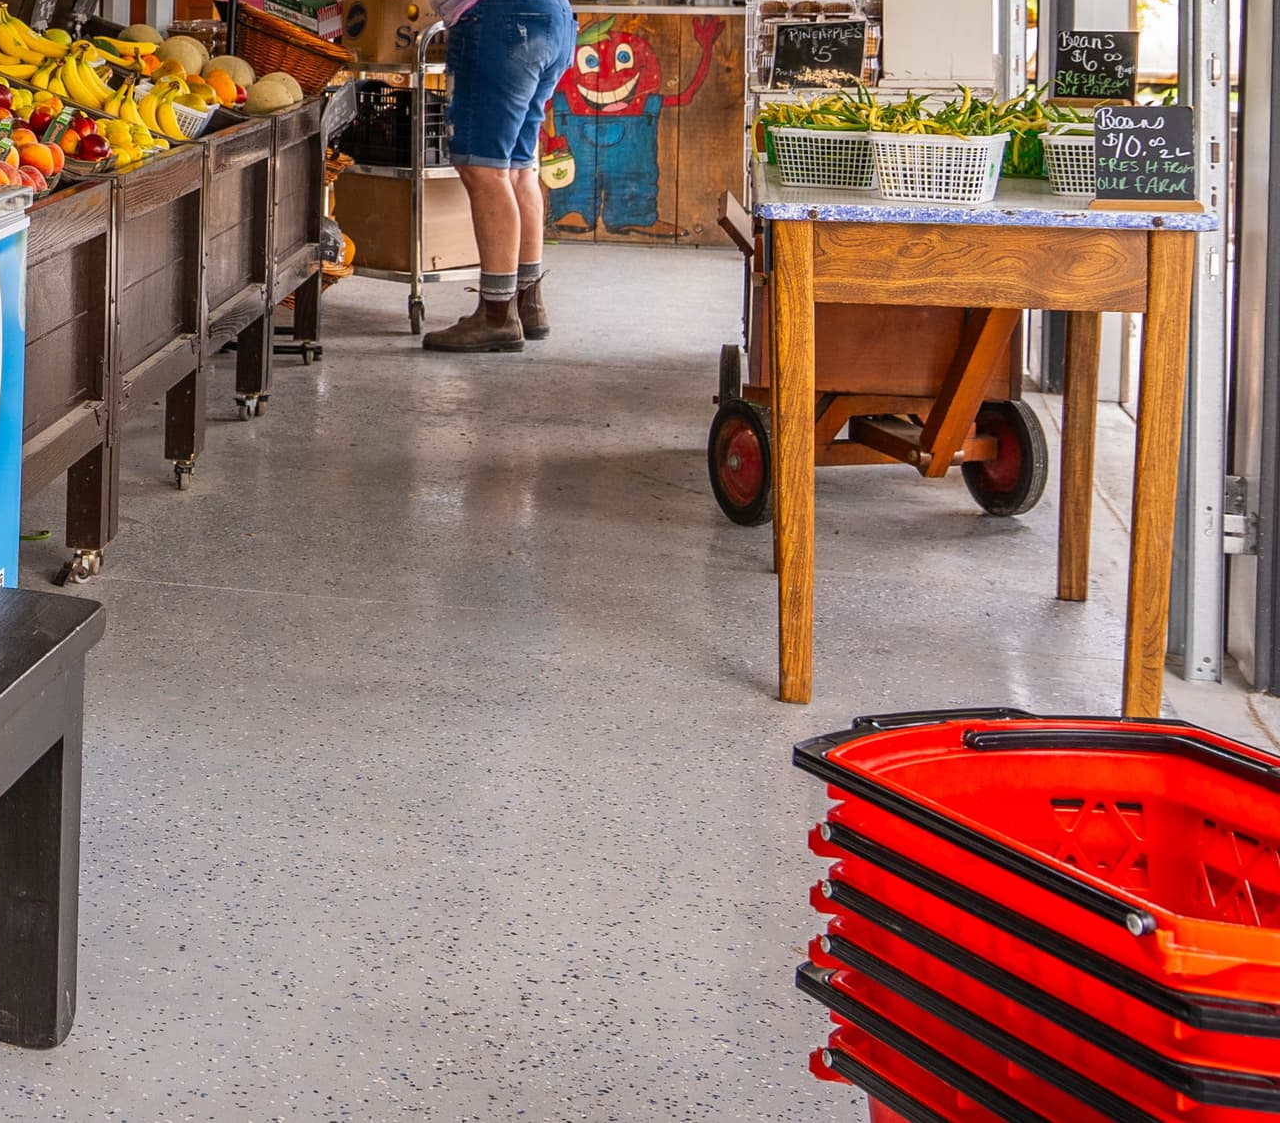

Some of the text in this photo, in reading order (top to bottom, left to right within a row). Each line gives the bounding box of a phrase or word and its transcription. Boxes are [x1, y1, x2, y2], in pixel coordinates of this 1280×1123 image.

[788, 26, 863, 42] PINEAPPLES
[1057, 30, 1116, 52] Beans
[1095, 107, 1165, 130] Beans
[1096, 174, 1189, 195] OUR FARM
